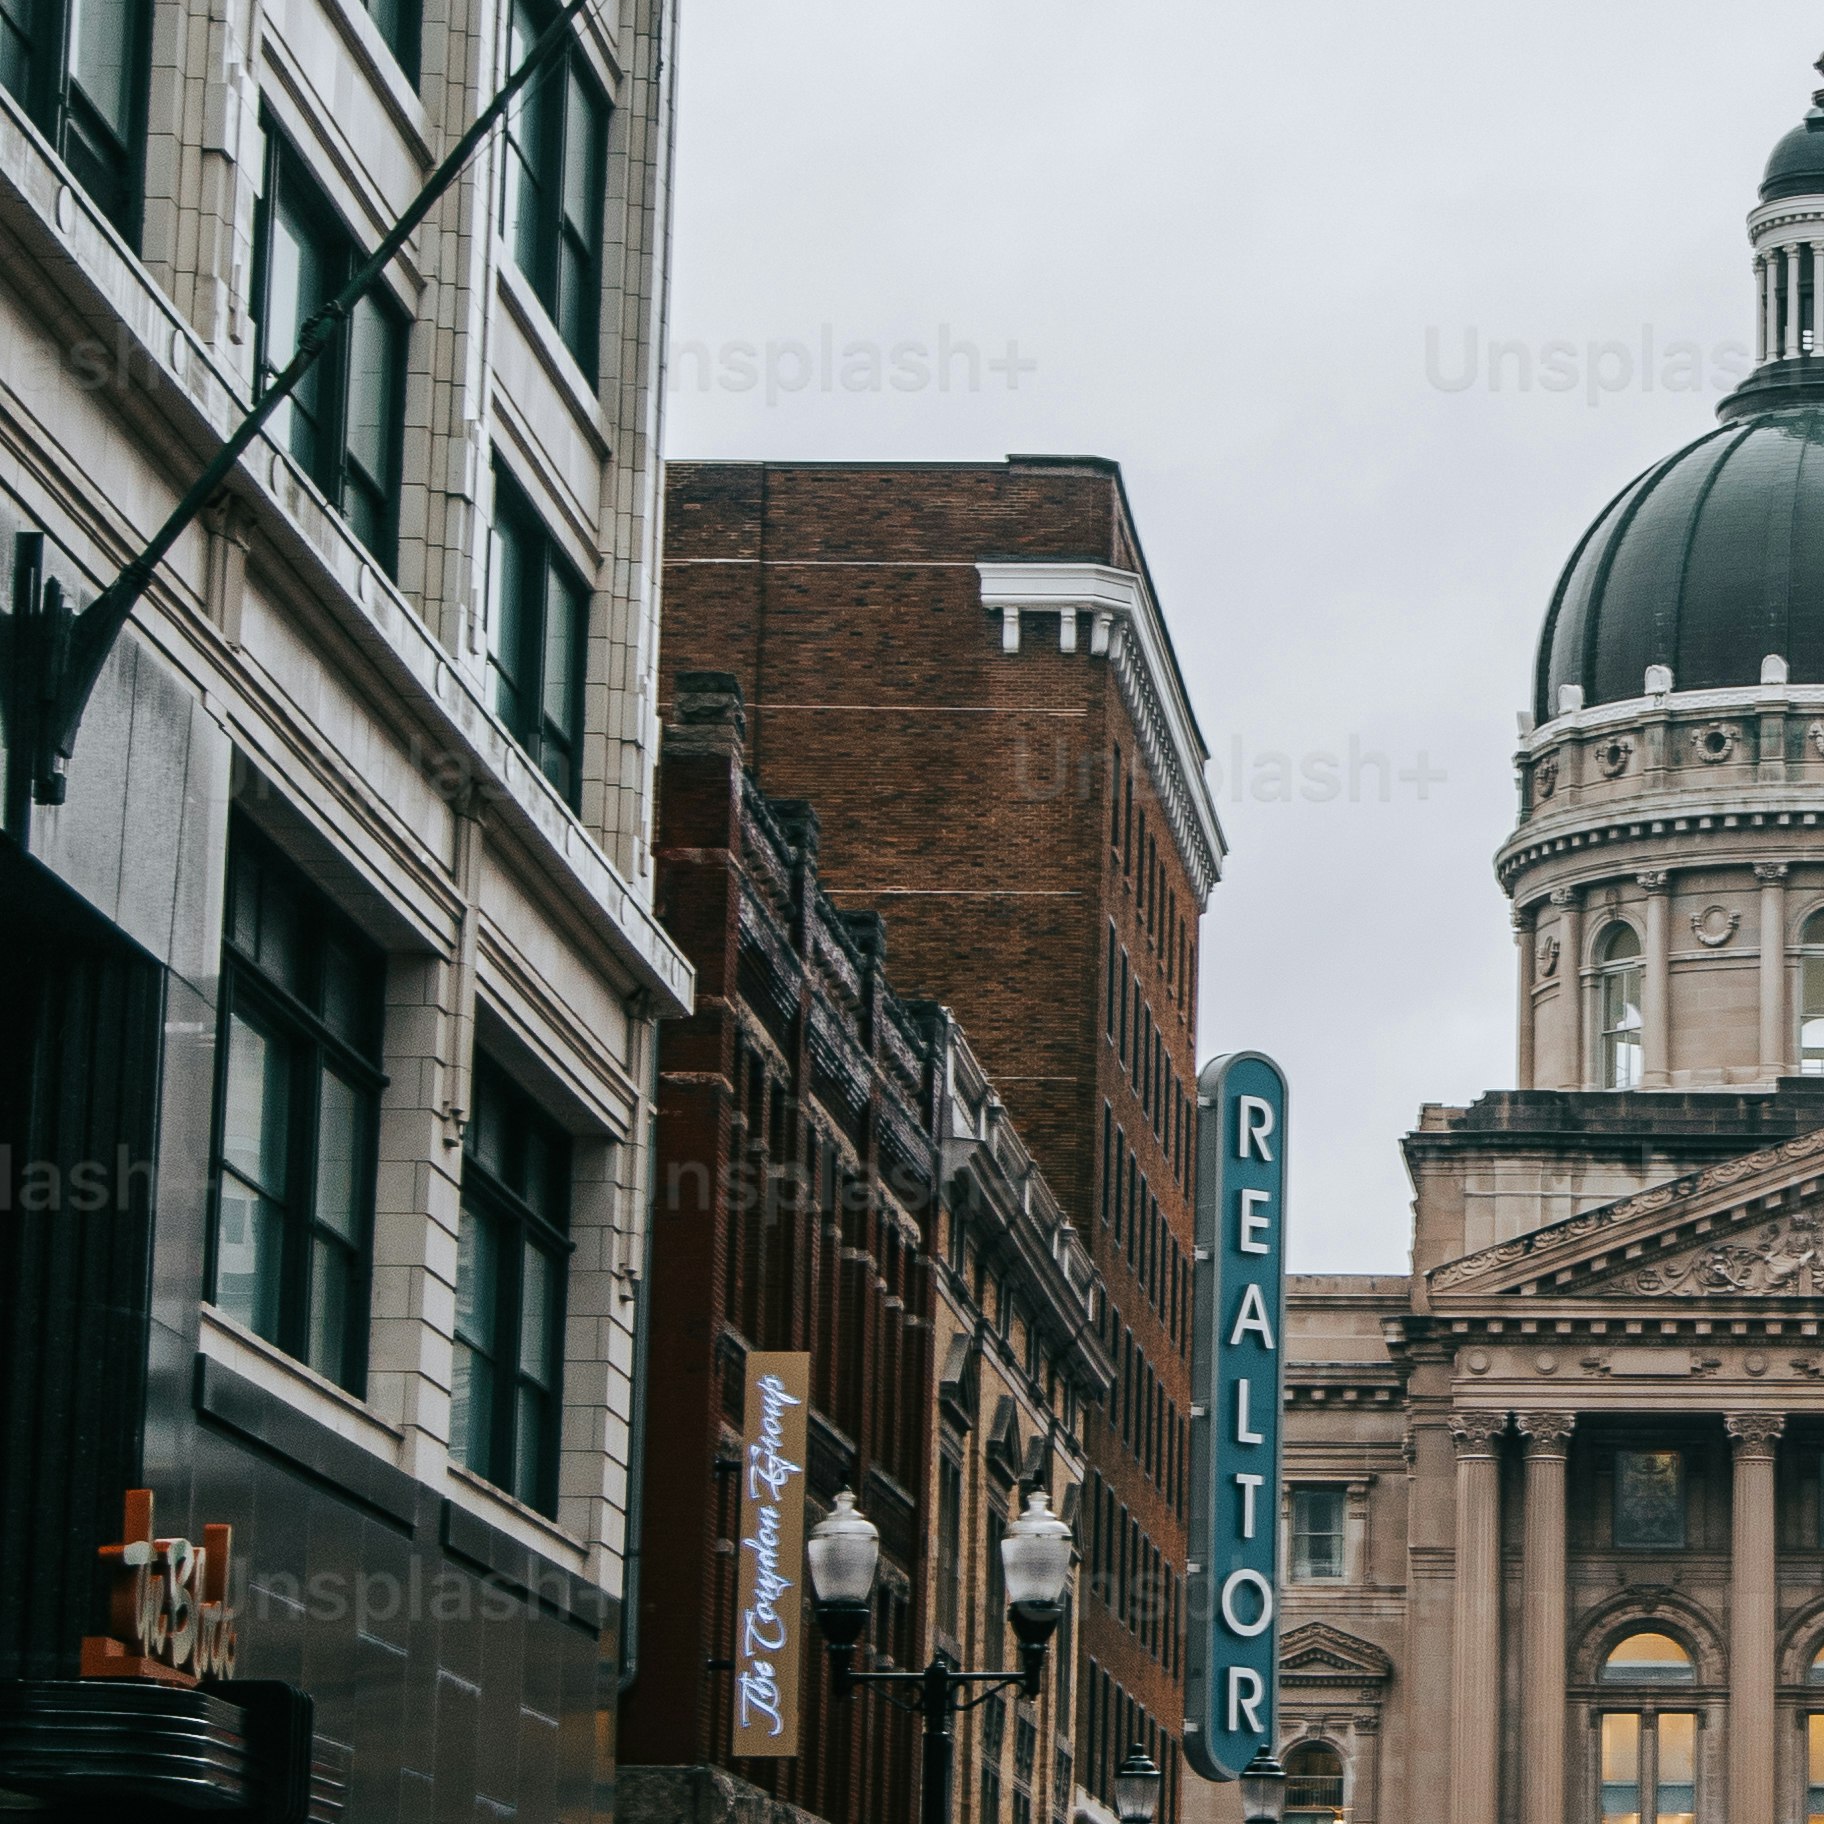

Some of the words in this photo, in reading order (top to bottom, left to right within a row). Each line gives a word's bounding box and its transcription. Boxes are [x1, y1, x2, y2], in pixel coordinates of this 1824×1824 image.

[750, 1374, 802, 1501] Group
[1221, 1094, 1275, 1734] REALTOR
[741, 1504, 794, 1657] Corydon
[737, 1660, 784, 1737] The
